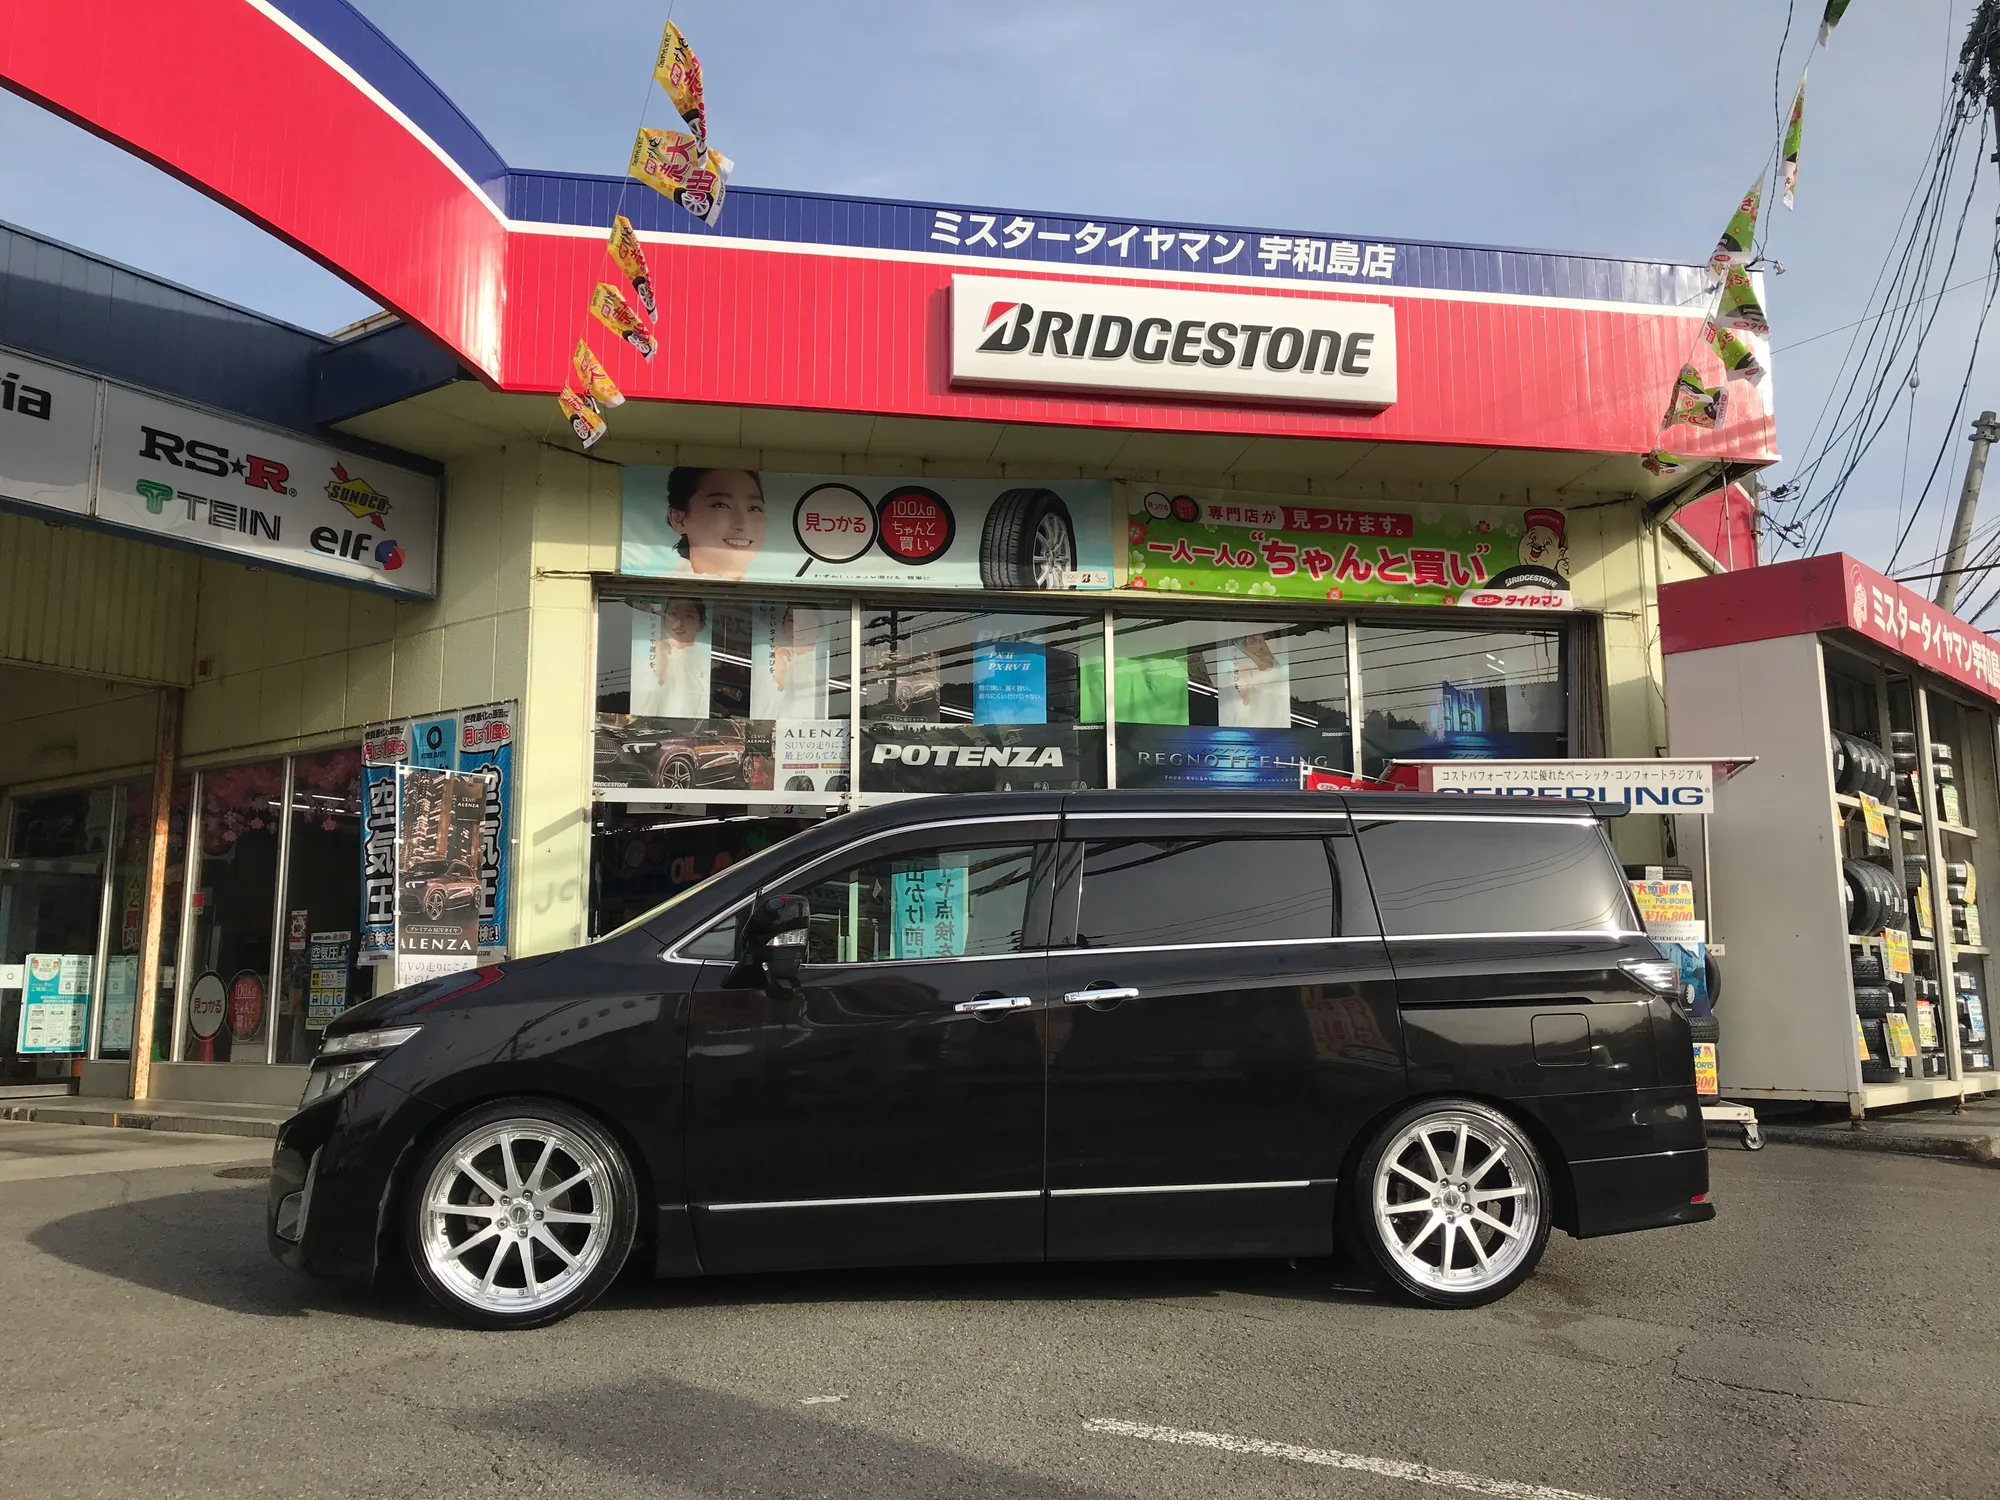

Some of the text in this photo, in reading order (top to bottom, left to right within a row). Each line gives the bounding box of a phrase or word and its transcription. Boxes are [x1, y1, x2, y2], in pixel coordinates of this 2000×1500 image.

[930, 210, 1396, 279] ミスタータイヤマン 宇和島店
[976, 301, 1375, 375] BRIDGESTONE
[0, 371, 51, 421] ia
[329, 482, 390, 513] SUNOCO
[177, 491, 281, 542] TEIN
[892, 501, 935, 516] 100人の
[805, 512, 866, 534] 見つかる
[892, 522, 935, 536] ちゃんと
[1207, 505, 1277, 524] 専門店が
[1292, 510, 1403, 536] 見つけます。
[310, 525, 373, 561] elf
[900, 537, 935, 551] 買い。
[1504, 573, 1558, 588] BRIDGESTONE
[1504, 594, 1563, 608] タイヤマン
[785, 741, 851, 750] SUVの走りにこ
[871, 743, 1064, 768] POTENZA
[1138, 751, 1219, 768] REGNO
[311, 945, 339, 962] 空気圧
[193, 997, 222, 1014] 見つかる
